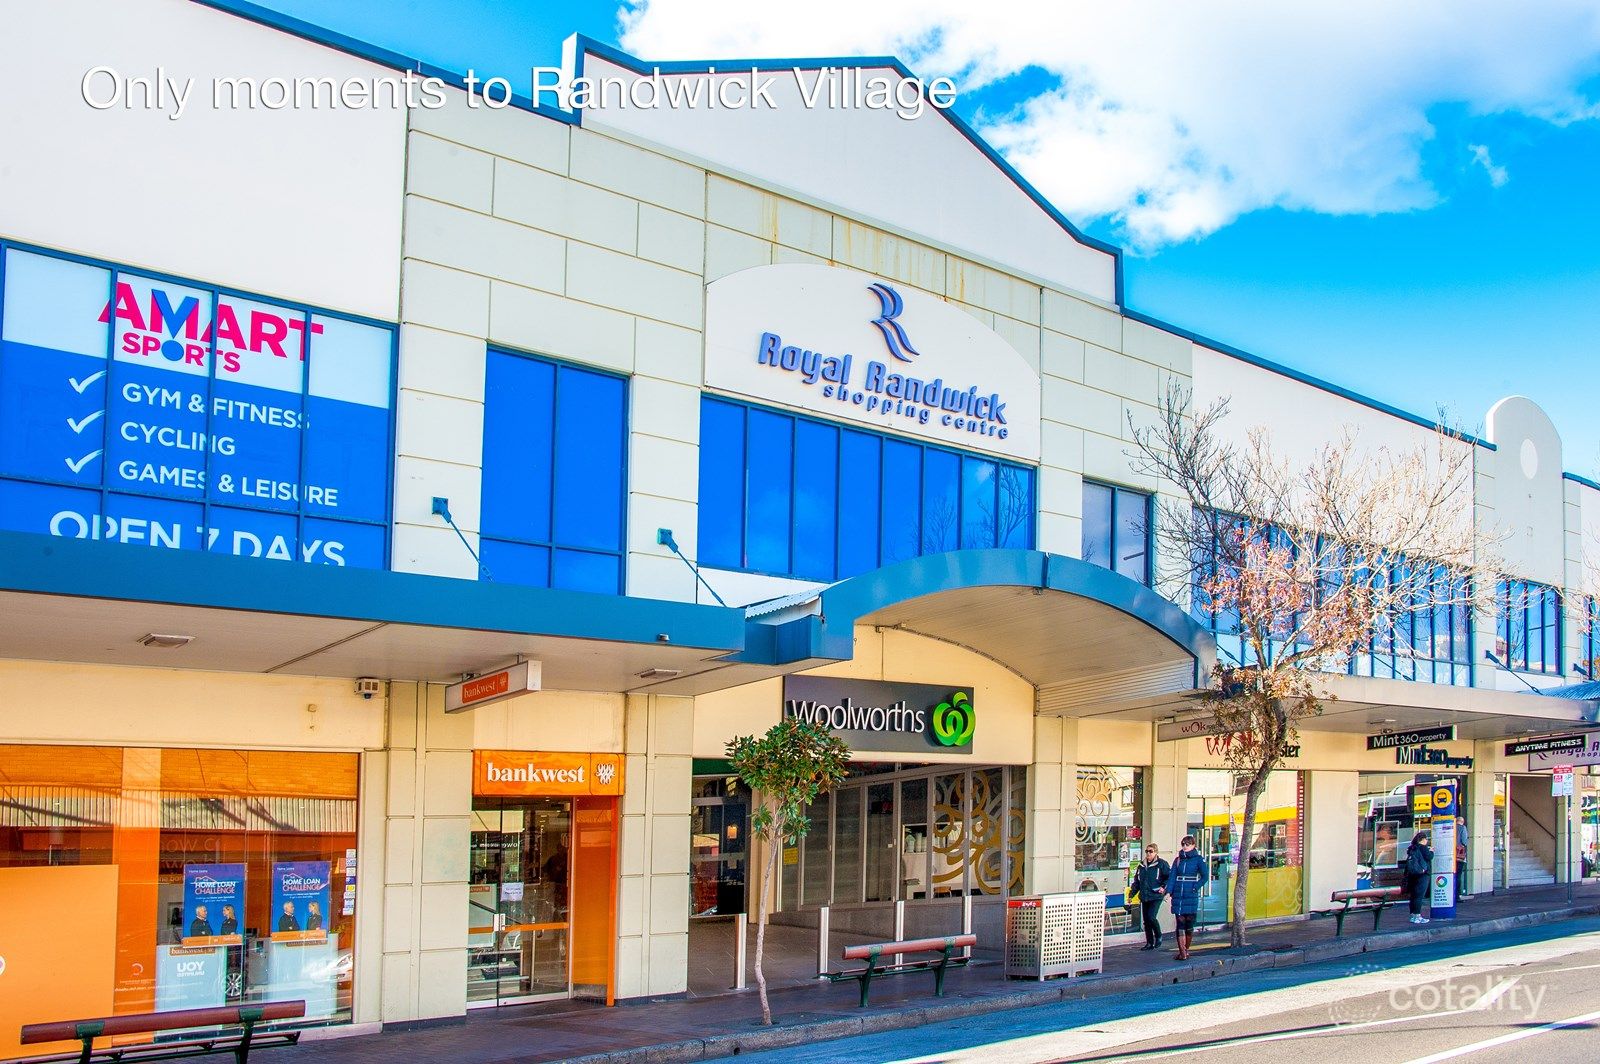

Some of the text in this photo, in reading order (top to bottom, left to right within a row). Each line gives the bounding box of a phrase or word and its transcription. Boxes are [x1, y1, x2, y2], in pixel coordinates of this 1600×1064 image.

[98, 281, 324, 362] AMART
[758, 331, 1008, 425] Royal Randwick
[122, 383, 181, 409] GYM
[188, 394, 205, 414] &
[823, 384, 1009, 439] shopping centre
[120, 421, 236, 456] CYCLING
[218, 473, 235, 493] &
[241, 476, 339, 507] LEISURE
[463, 680, 496, 699] bankwest
[787, 697, 925, 733] Woolworths
[1515, 739, 1582, 752] ANYTIME FITNESS
[486, 762, 585, 783] bankwest
